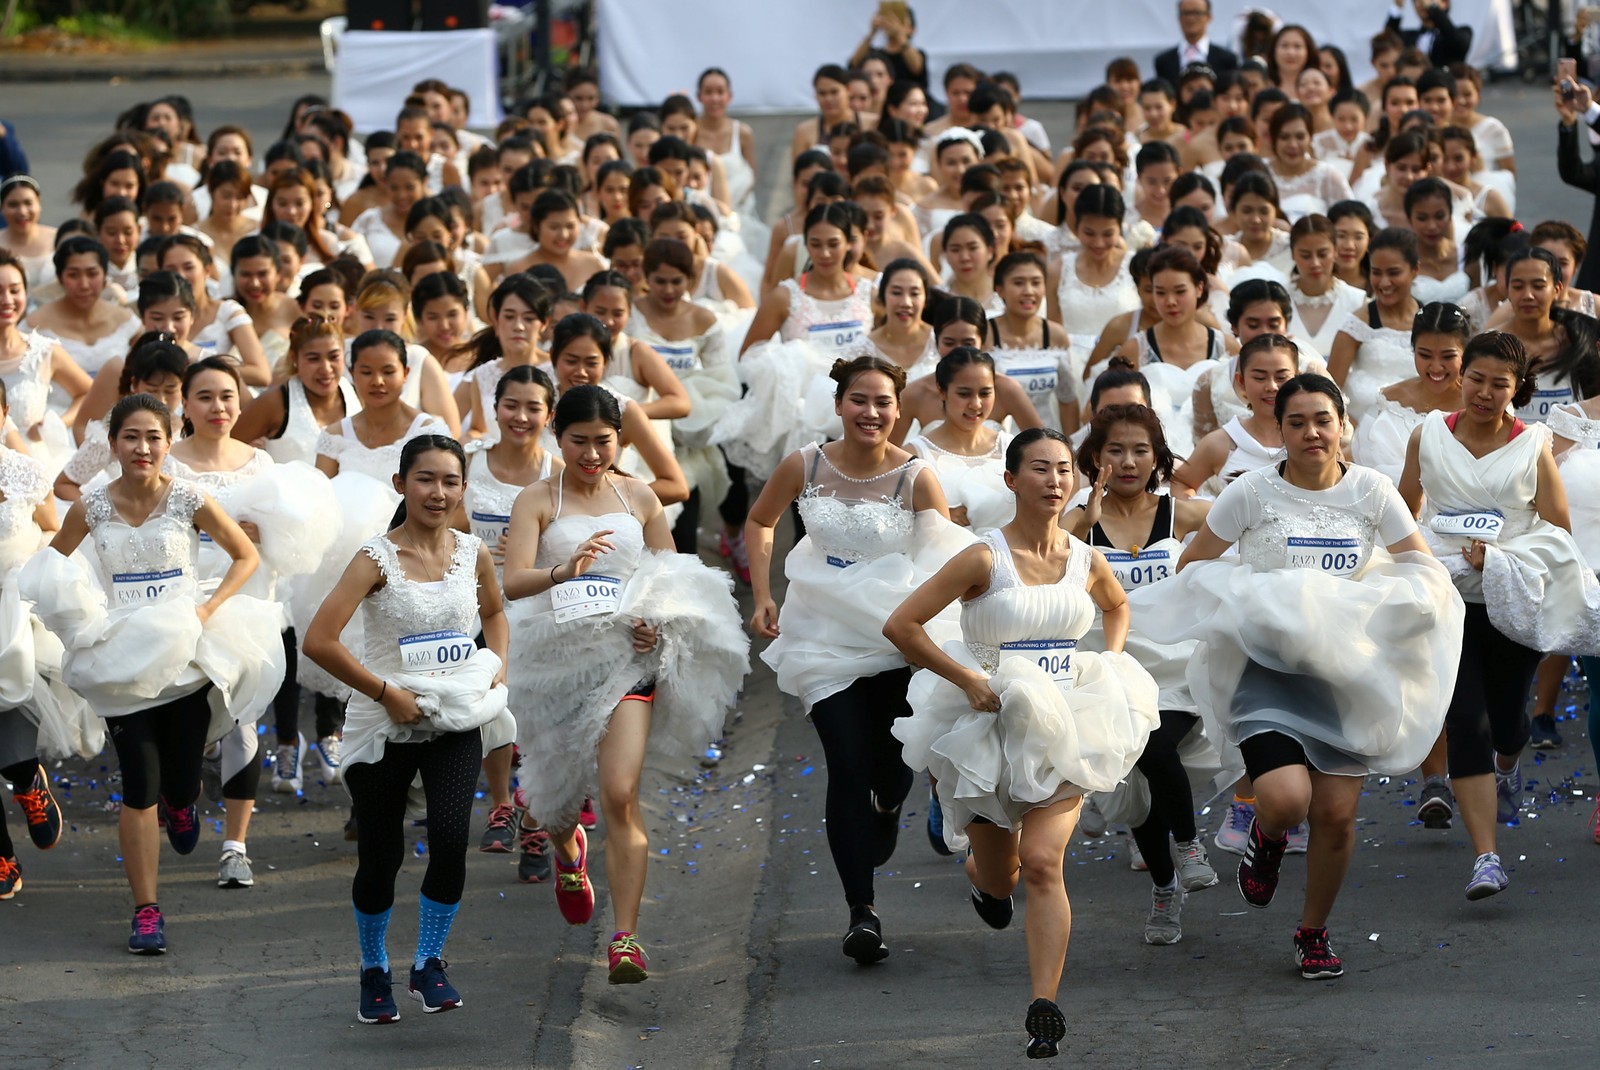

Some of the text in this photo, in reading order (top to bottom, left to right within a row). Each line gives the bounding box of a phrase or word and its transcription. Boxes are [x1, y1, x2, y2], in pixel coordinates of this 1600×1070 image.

[836, 331, 863, 346] 04
[1029, 377, 1055, 391] 034
[1463, 516, 1499, 532] 002
[1321, 553, 1358, 570] 003
[1130, 565, 1168, 584] 013
[437, 643, 473, 663] 007
[1037, 654, 1071, 675] 004
